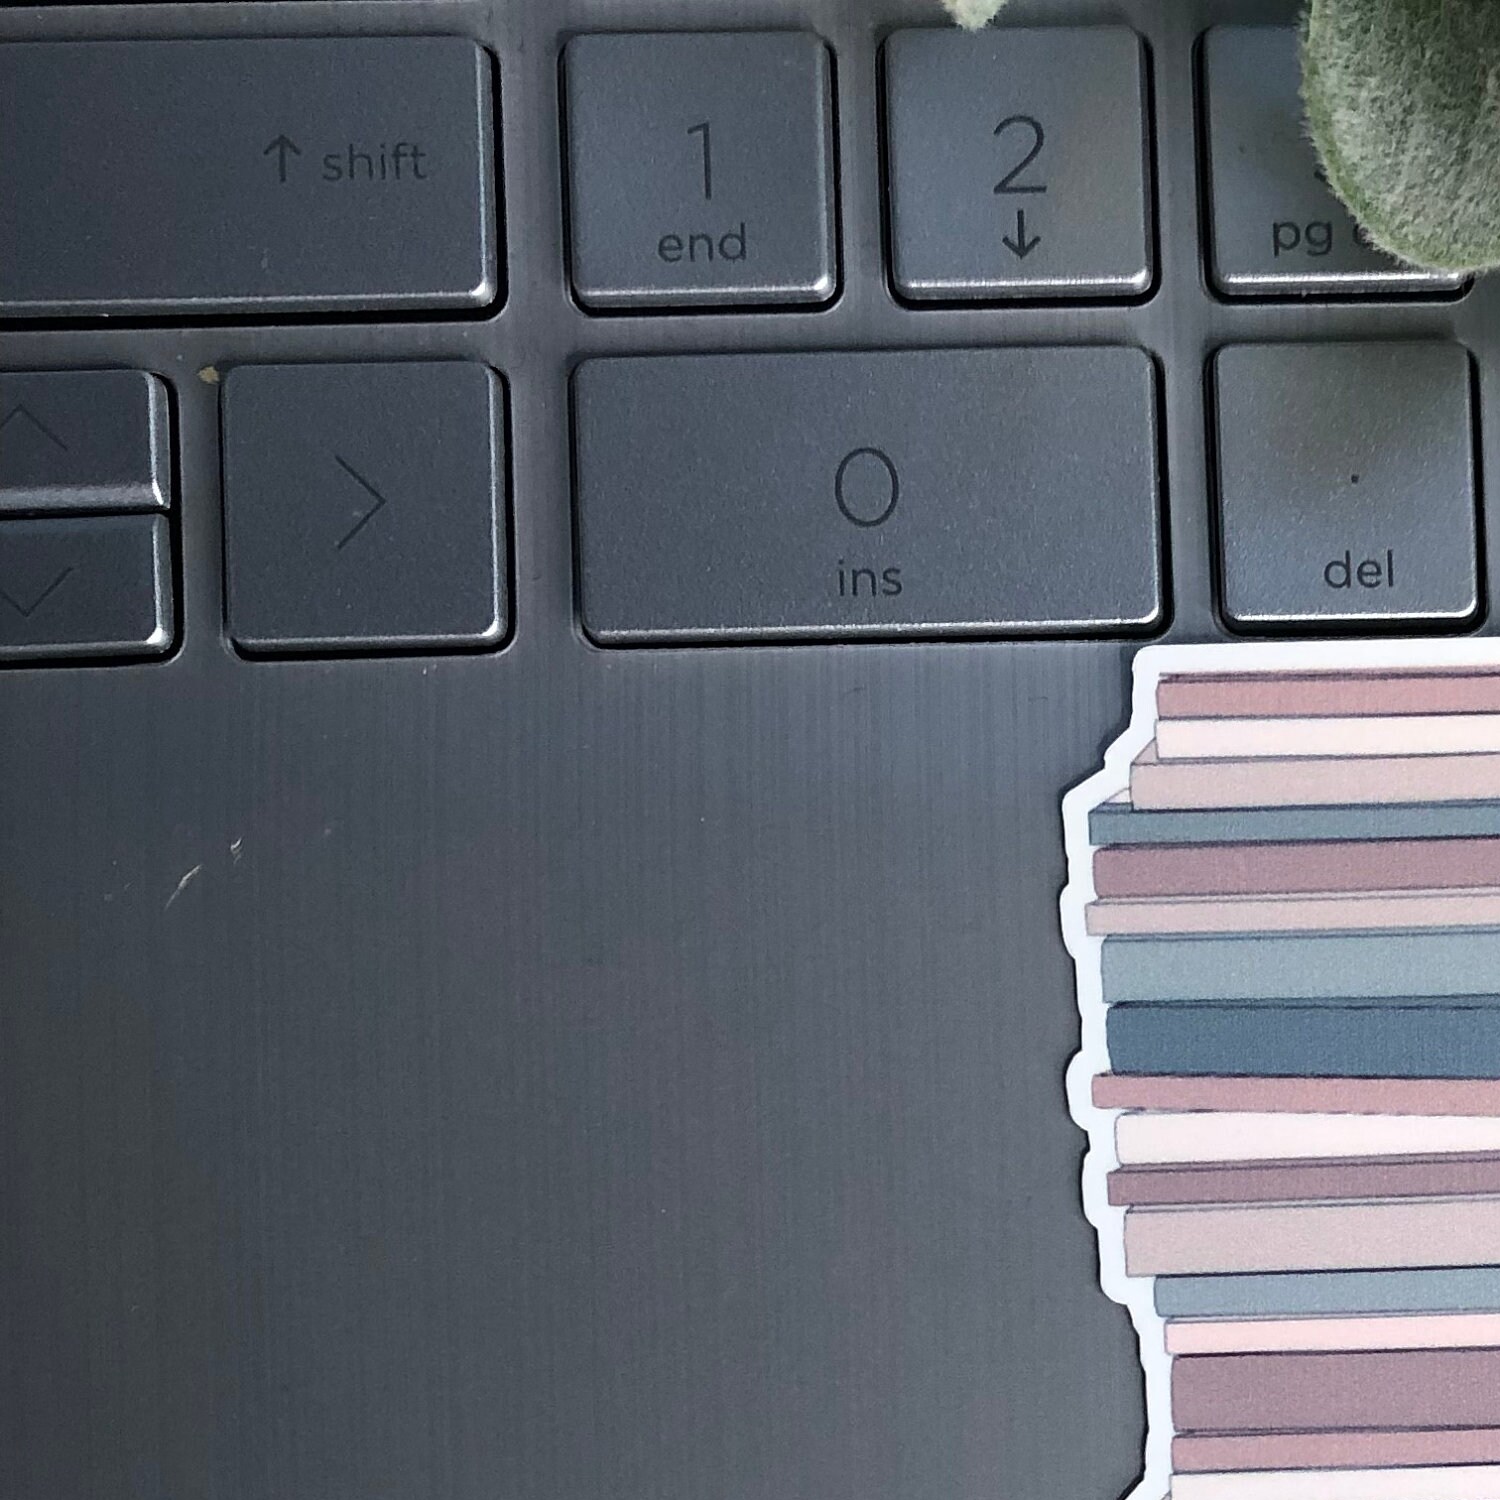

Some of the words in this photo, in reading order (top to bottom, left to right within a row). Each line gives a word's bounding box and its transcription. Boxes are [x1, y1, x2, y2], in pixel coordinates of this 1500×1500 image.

[322, 142, 428, 182] shift
[687, 121, 712, 200] 1
[993, 115, 1047, 194] 2
[657, 221, 747, 263] end
[1273, 221, 1332, 257] pg
[834, 447, 899, 527] 0
[837, 558, 903, 597] ins
[1324, 549, 1394, 589] del
